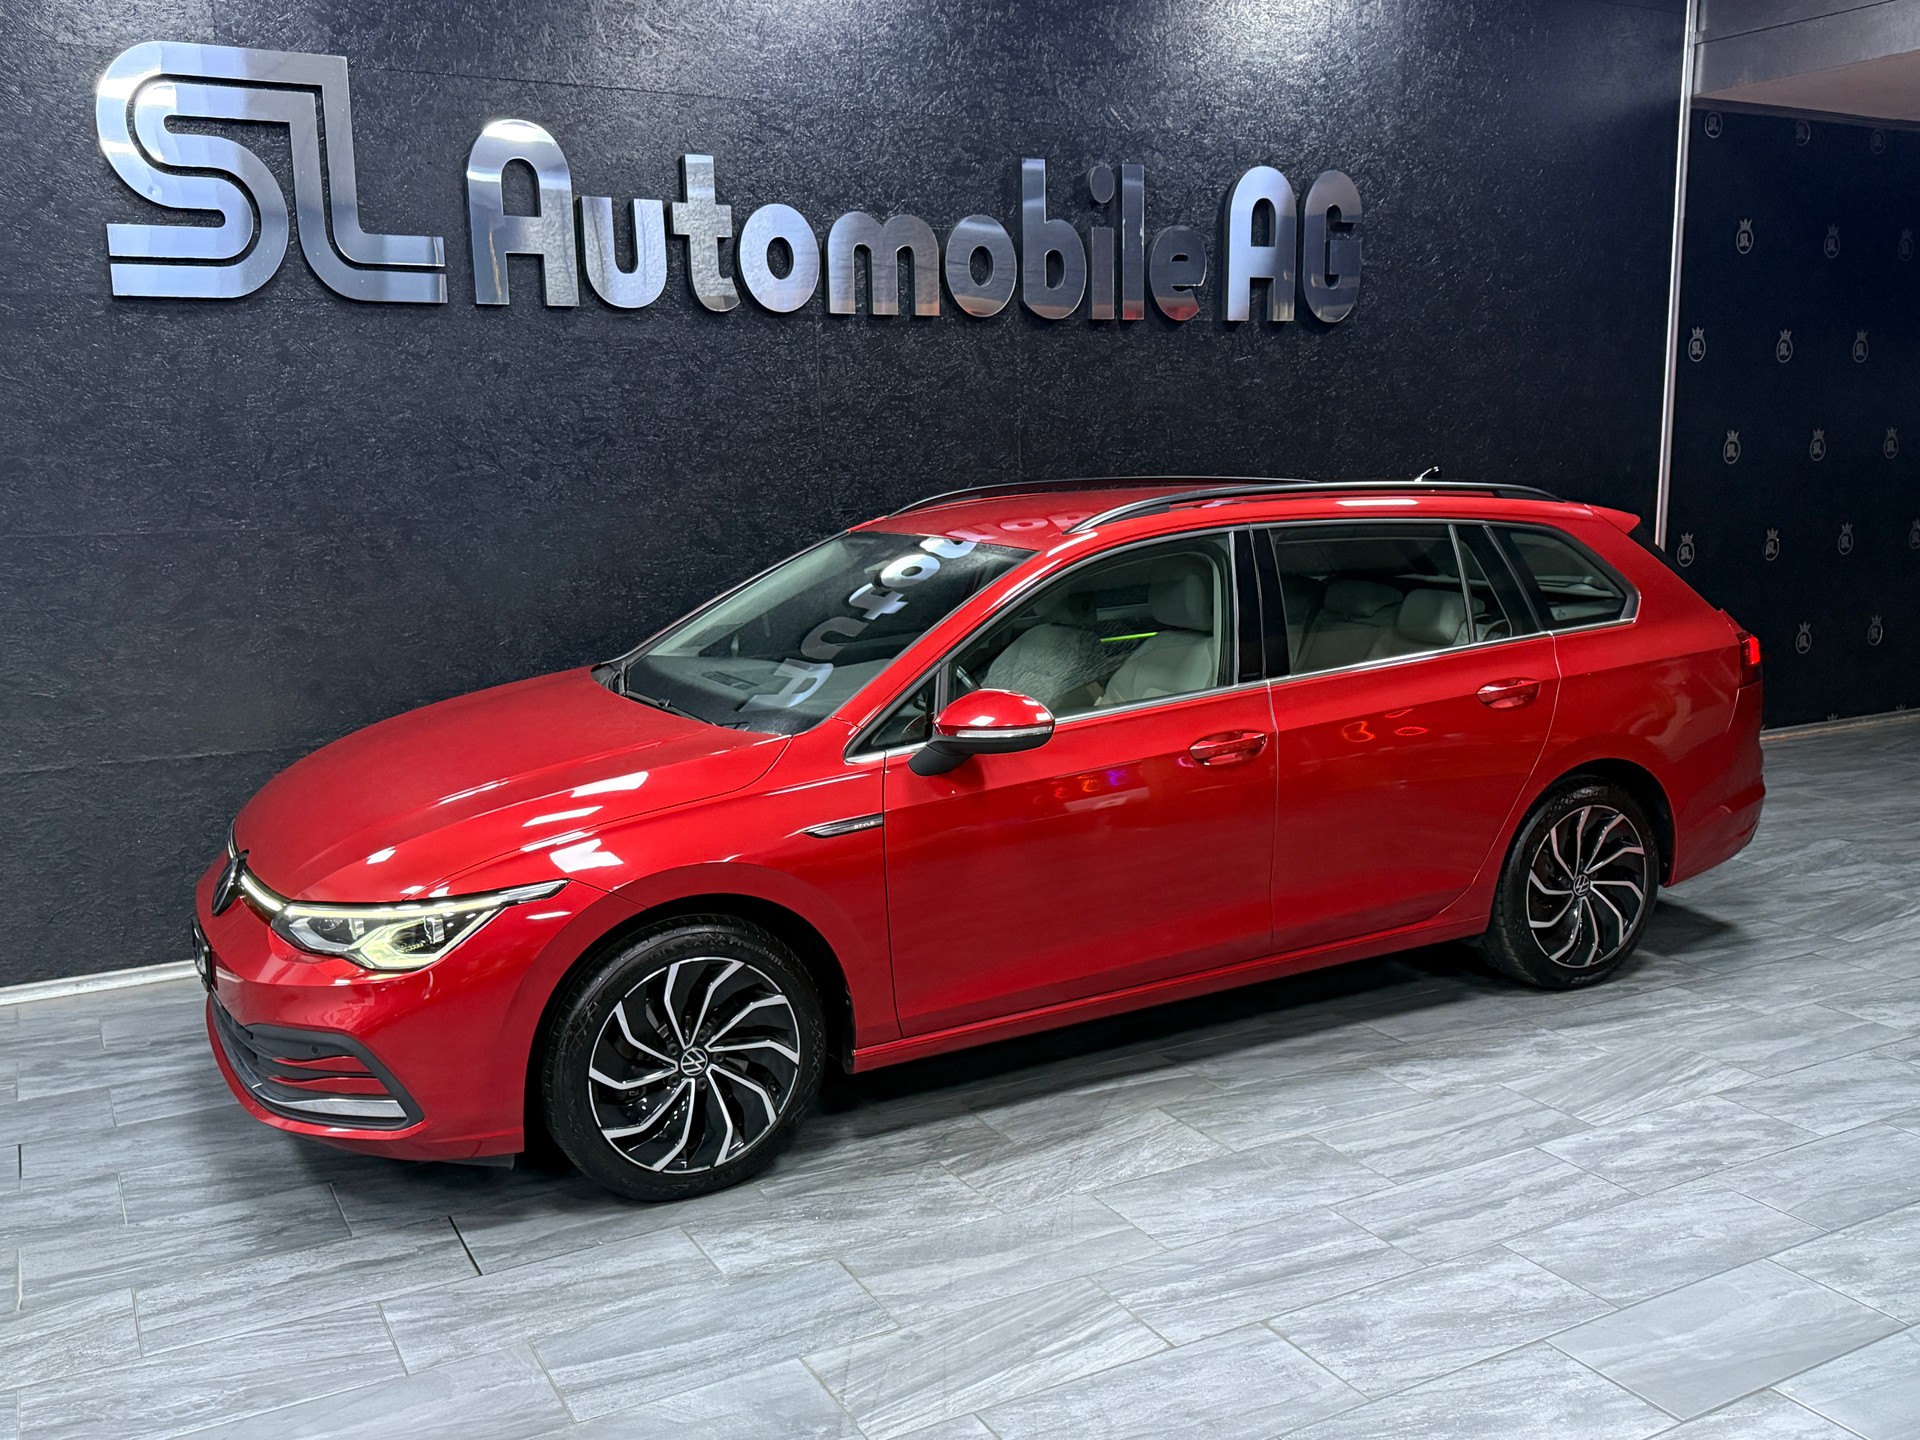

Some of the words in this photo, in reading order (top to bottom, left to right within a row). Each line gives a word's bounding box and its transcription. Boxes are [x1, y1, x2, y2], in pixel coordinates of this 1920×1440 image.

[96, 41, 448, 303] SL
[466, 118, 1207, 323] Automobile
[1226, 165, 1363, 323] AG
